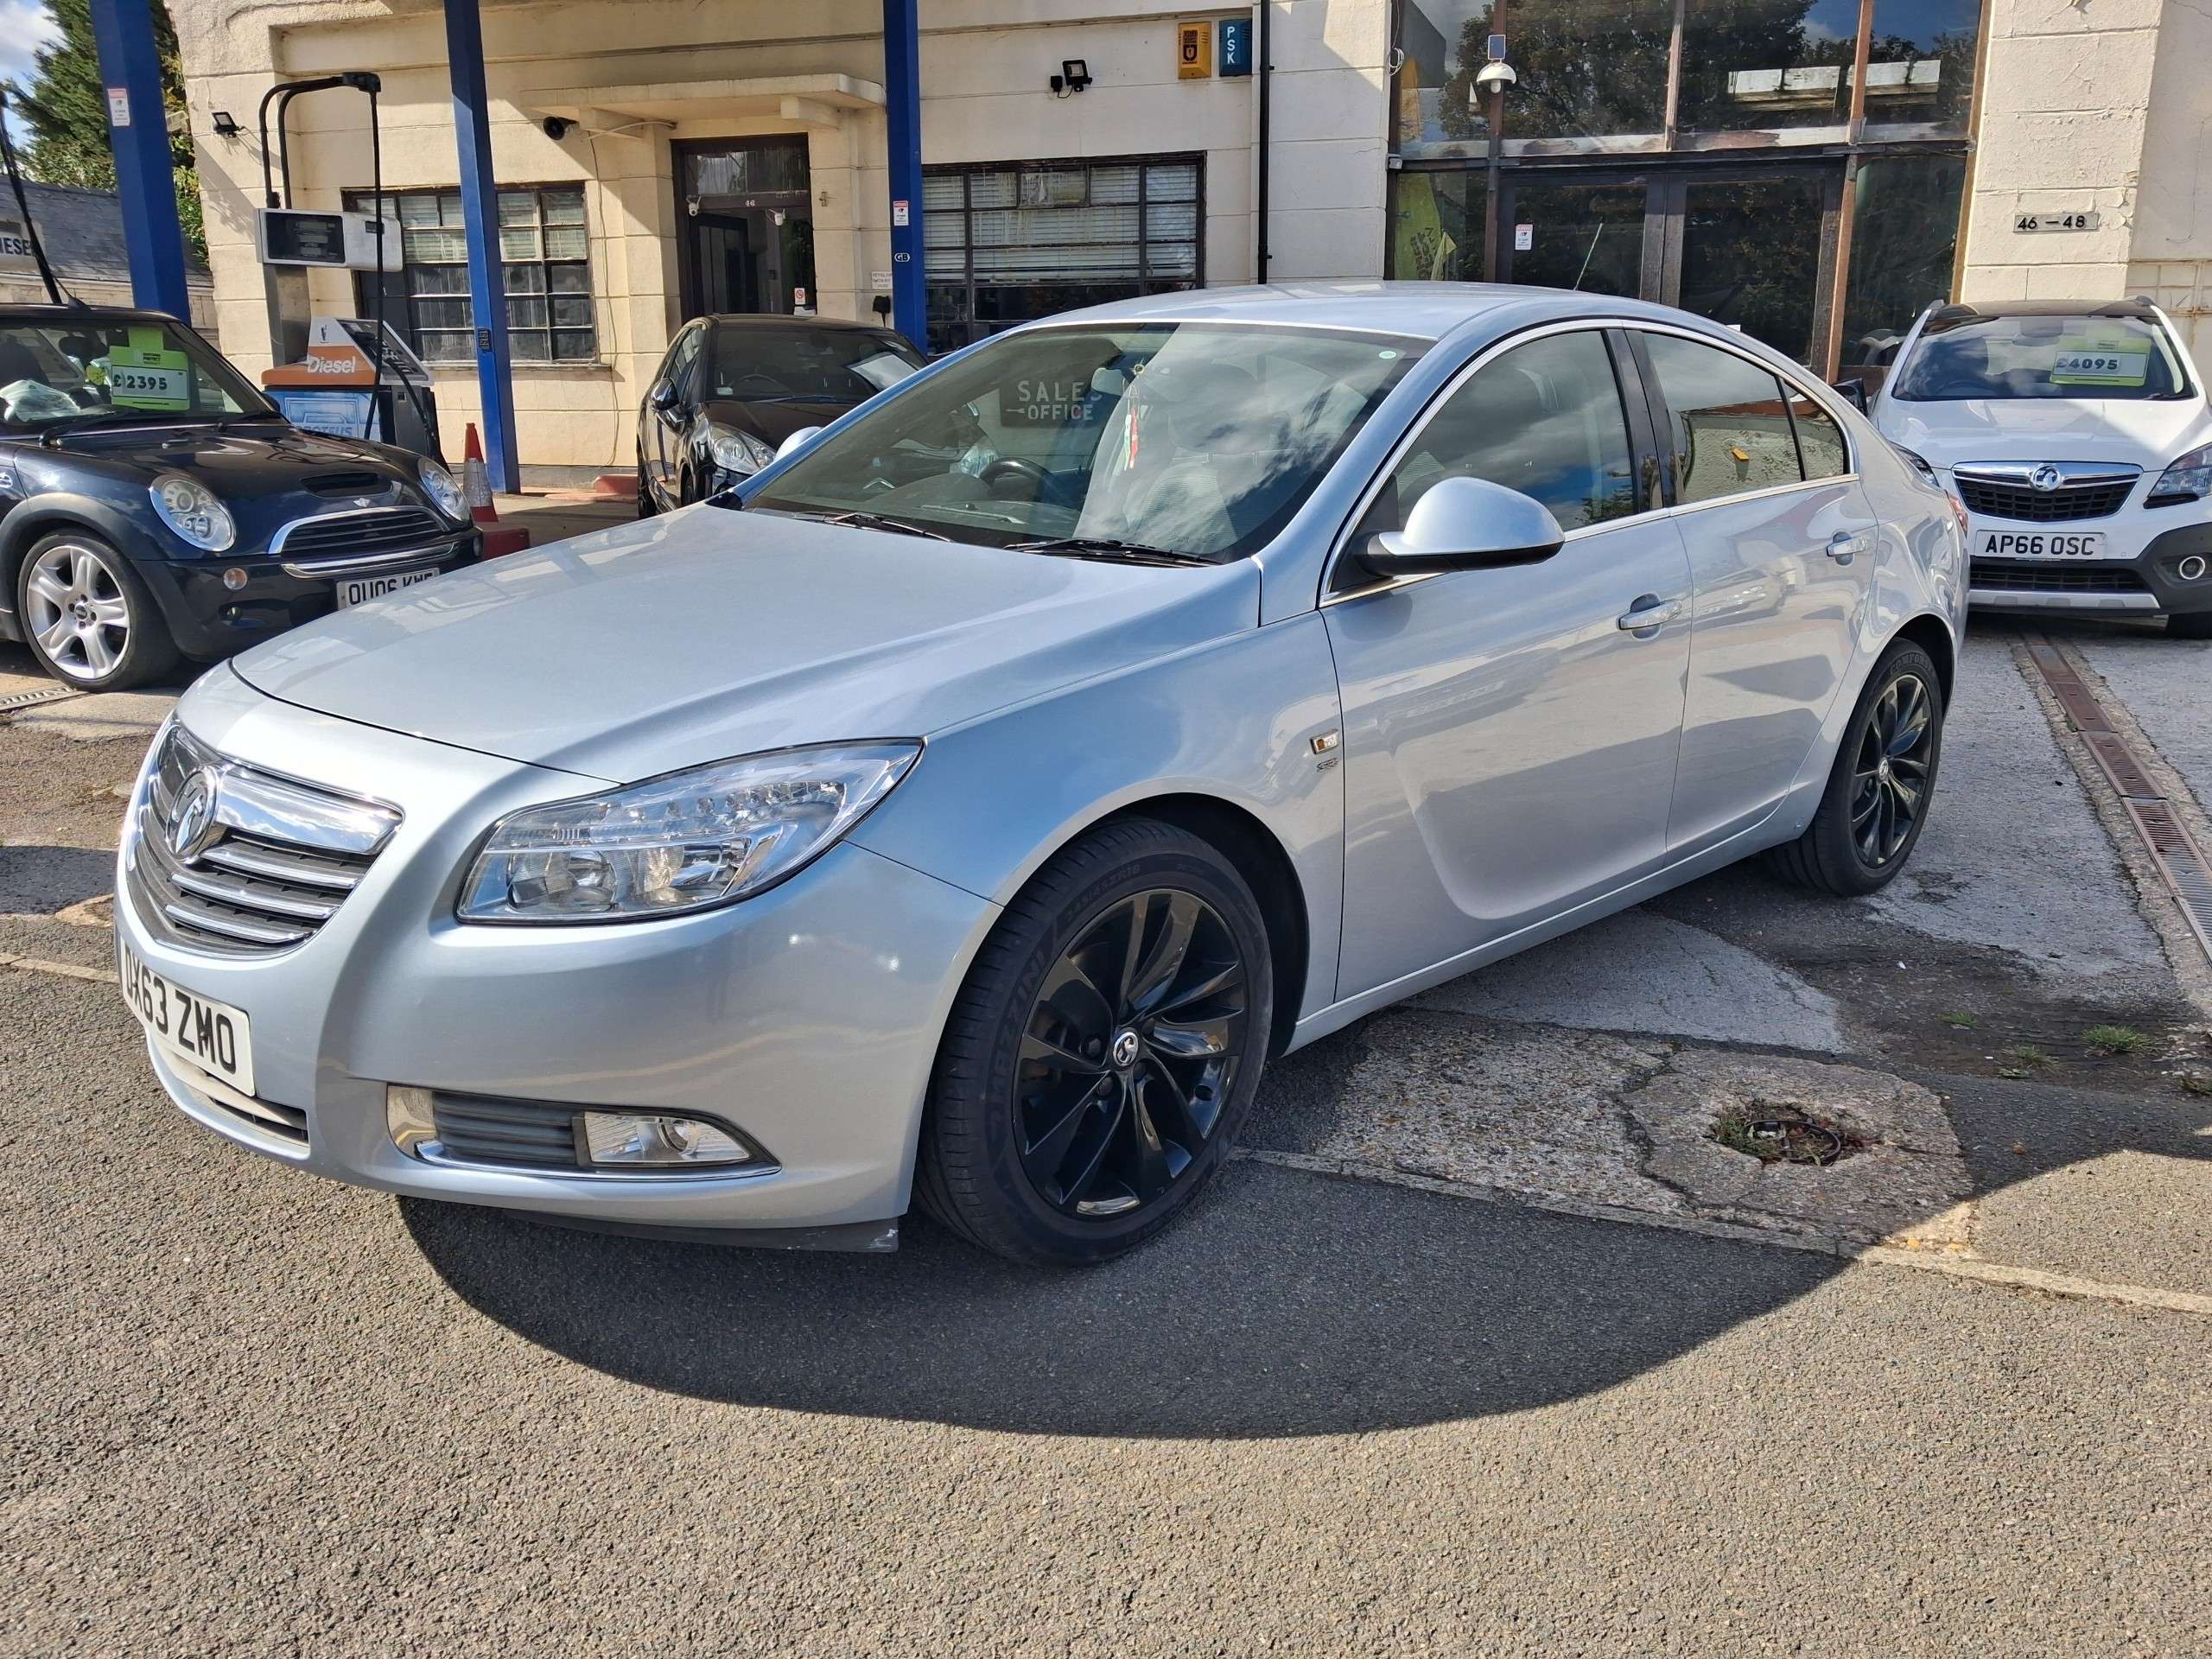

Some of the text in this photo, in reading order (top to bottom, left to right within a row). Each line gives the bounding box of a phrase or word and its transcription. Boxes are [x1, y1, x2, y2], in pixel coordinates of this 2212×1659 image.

[307, 355, 355, 373] Diesel
[1027, 404, 1094, 421] OFFICE
[1986, 534, 2095, 556] AP66 OSC
[175, 988, 237, 1075] ZMO
